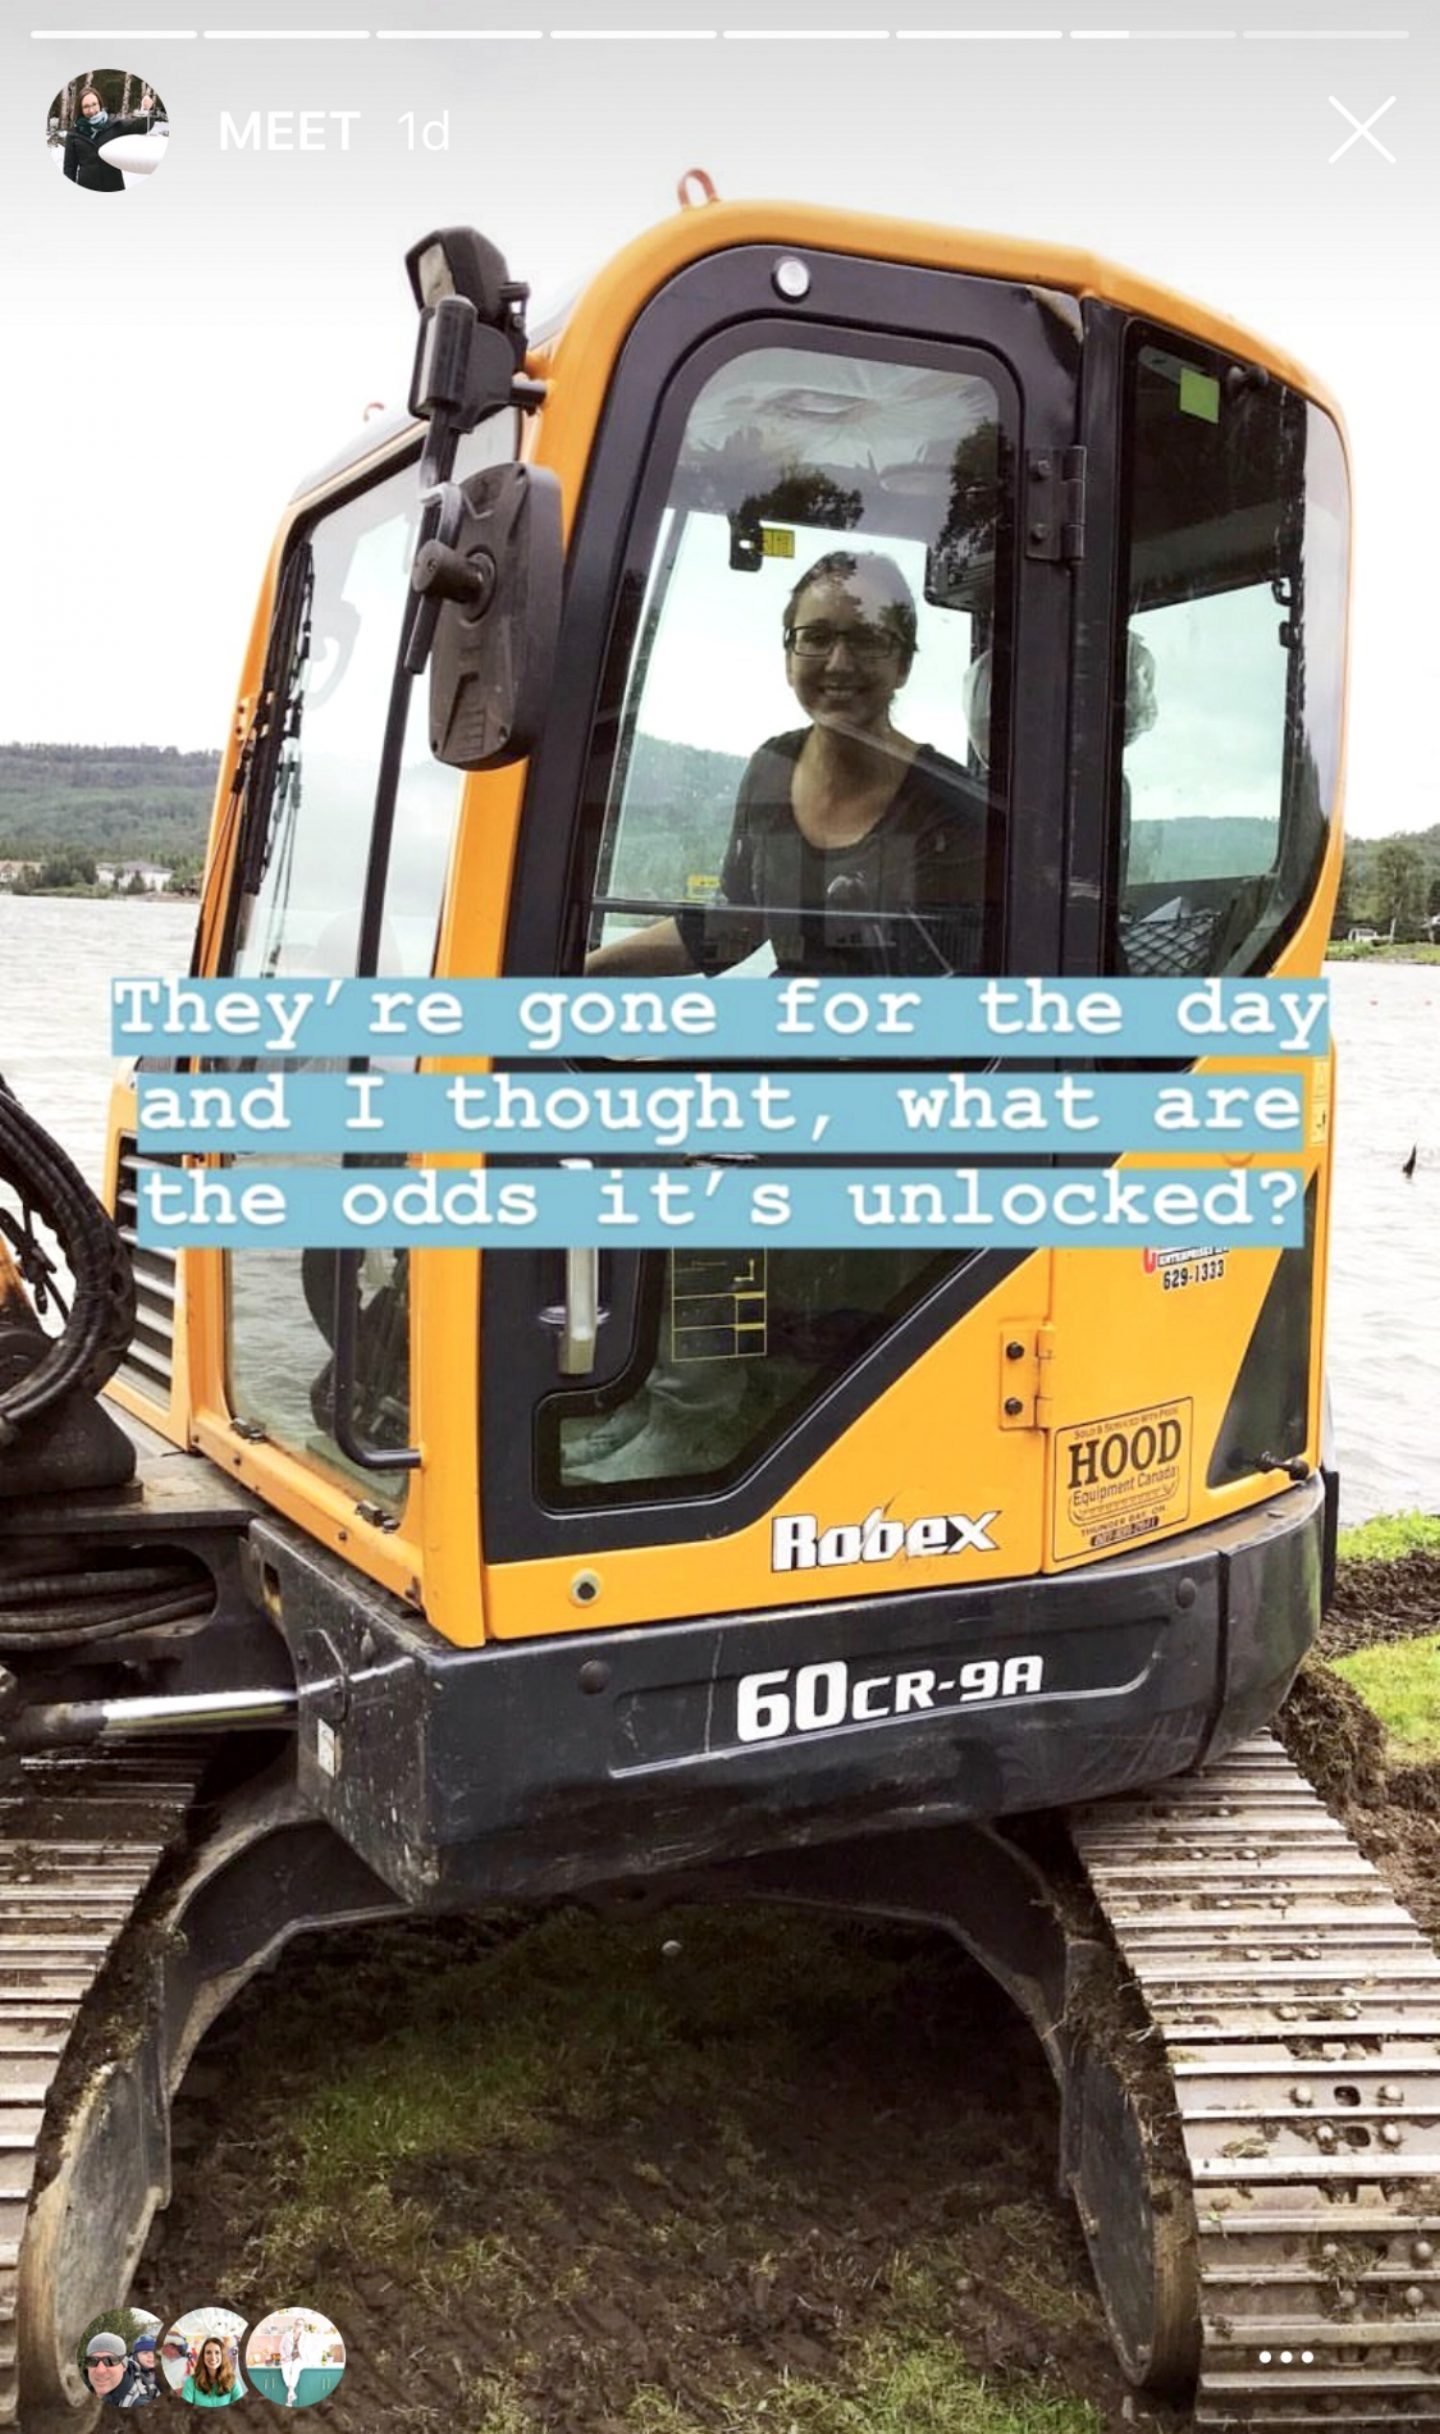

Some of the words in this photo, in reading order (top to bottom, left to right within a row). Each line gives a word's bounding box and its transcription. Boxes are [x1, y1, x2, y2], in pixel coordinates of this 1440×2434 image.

[1163, 1259, 1225, 1290] 629-1333
[1068, 1419, 1182, 1489] HOOD
[1073, 1477, 1136, 1507] Equipment
[1137, 1466, 1176, 1488] Canada
[771, 1508, 1001, 1573] Robex
